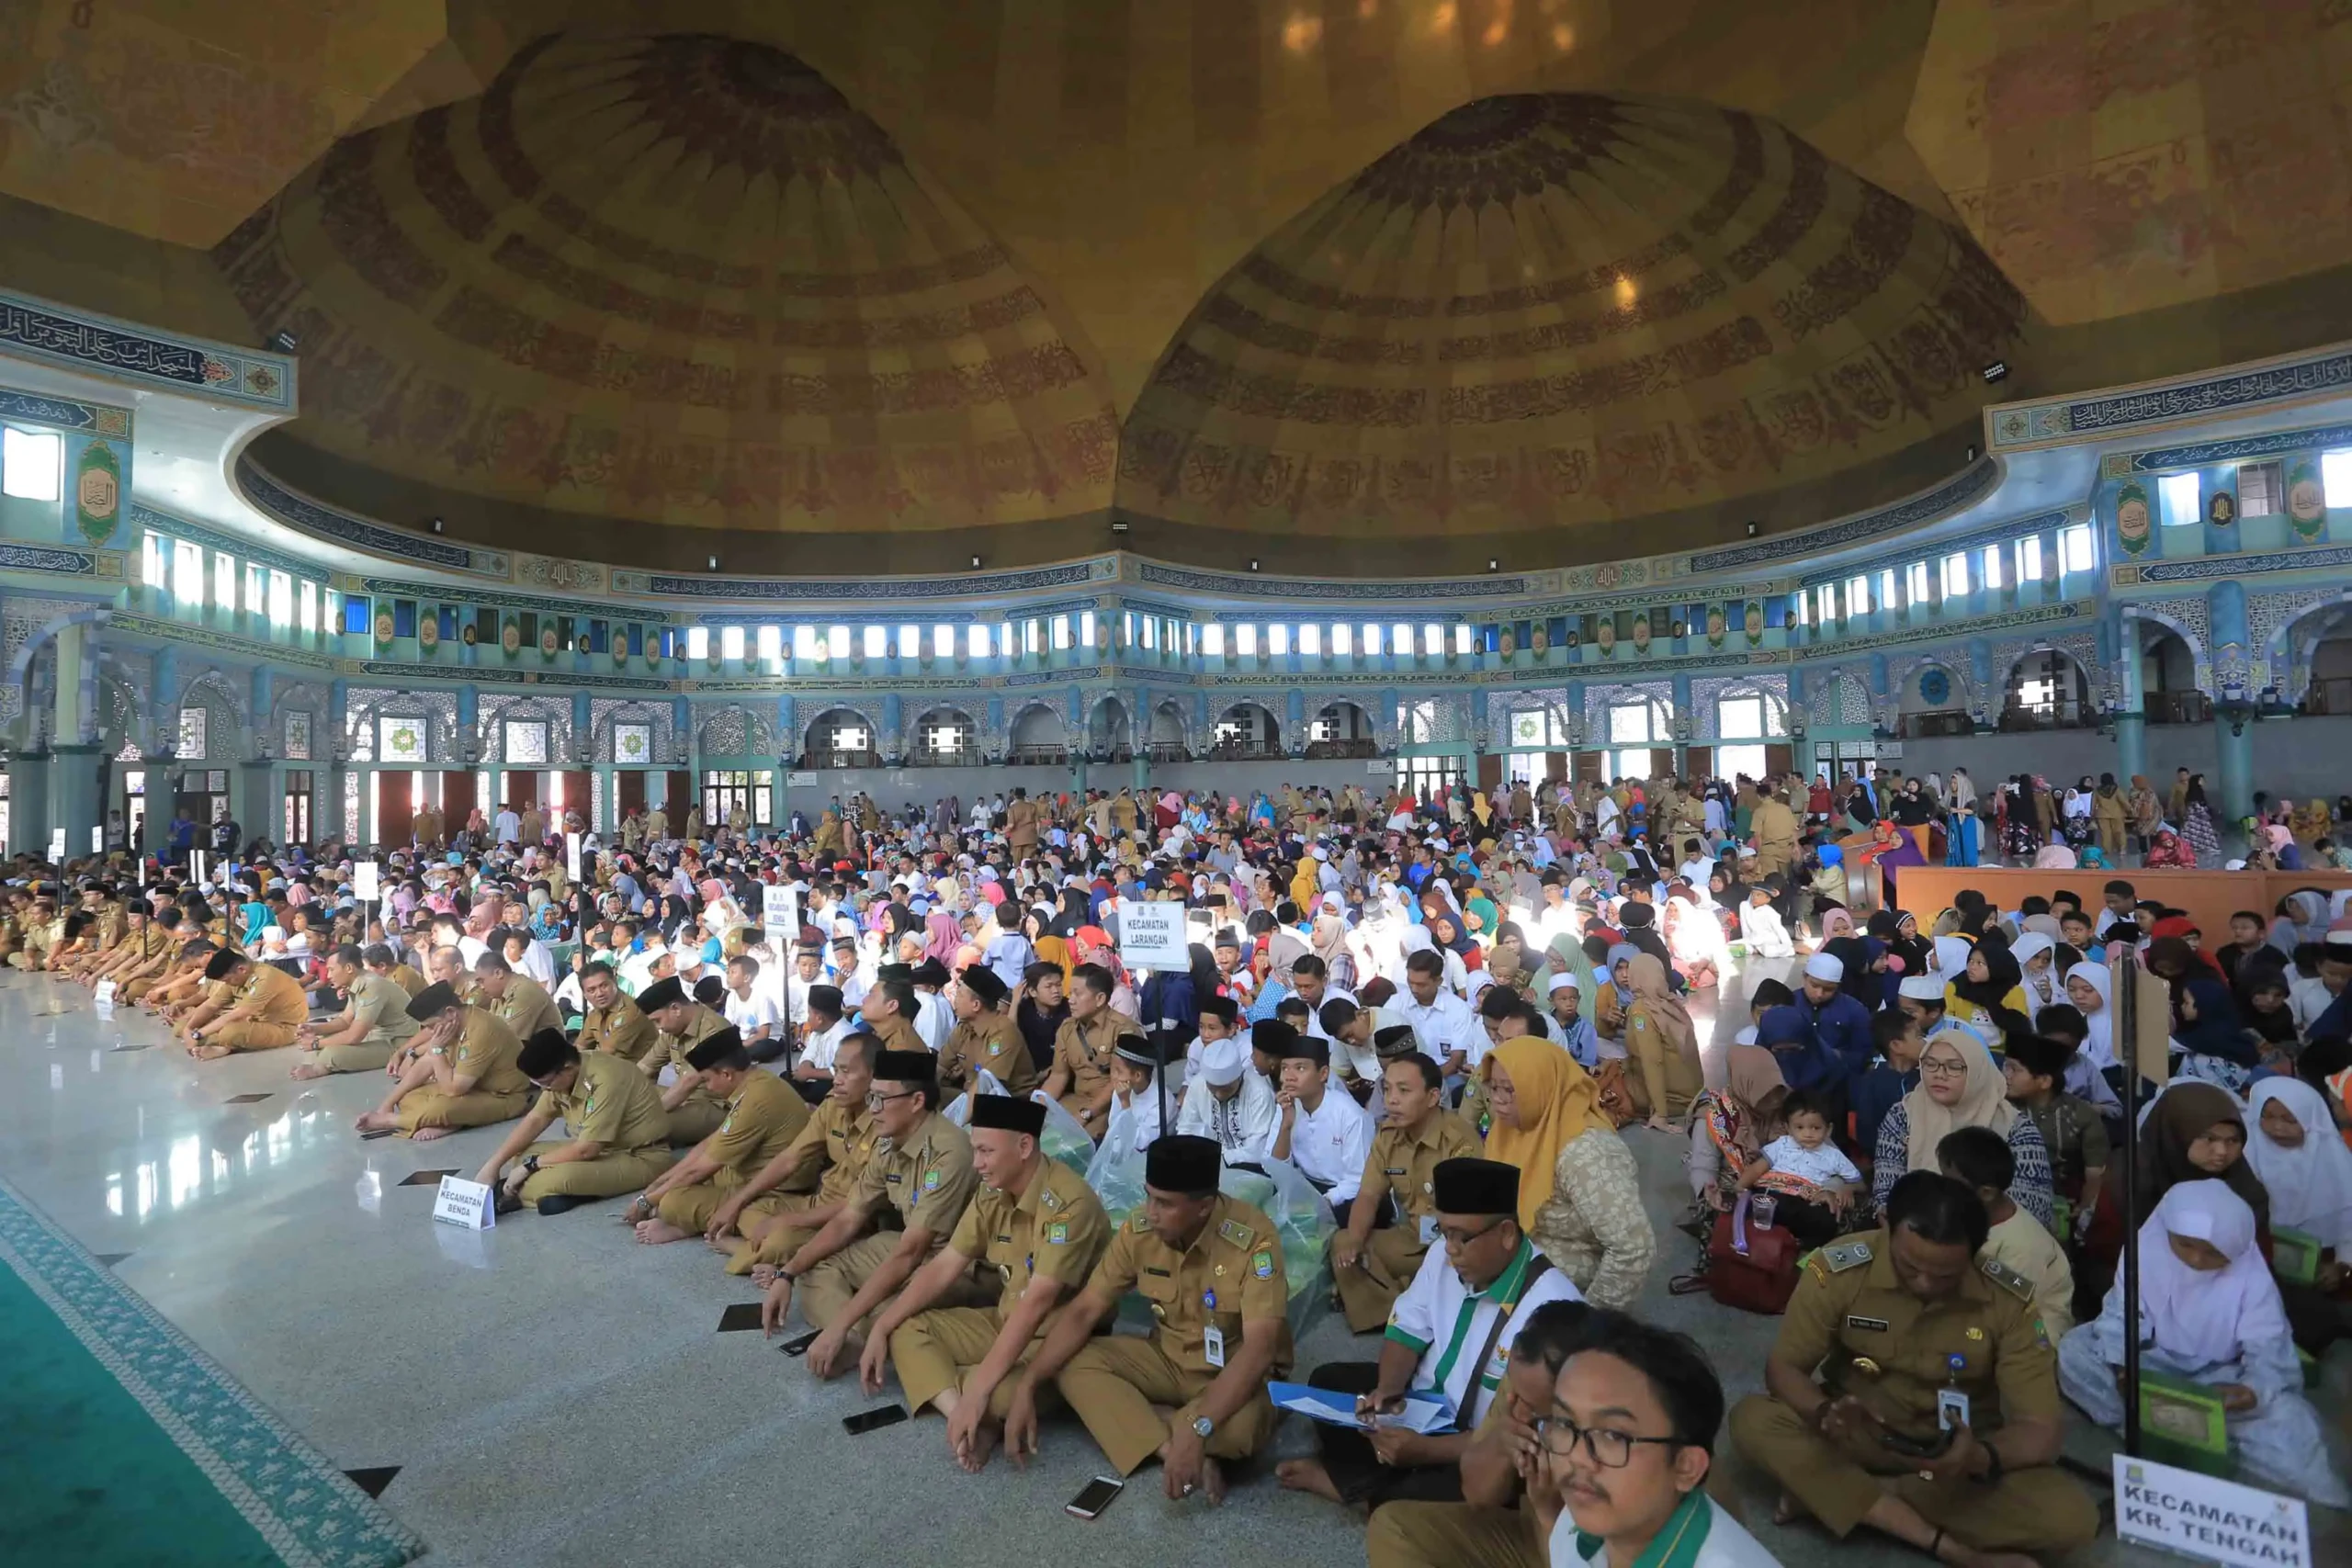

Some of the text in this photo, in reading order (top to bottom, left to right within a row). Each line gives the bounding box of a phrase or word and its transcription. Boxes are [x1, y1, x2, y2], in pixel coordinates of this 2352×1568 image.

[1128, 919, 1169, 930] KECAMATAN
[1132, 934, 1168, 944] LARANGAN
[441, 1190, 481, 1207] KECAMATAN
[447, 1204, 470, 1216] BENDA
[2124, 1484, 2299, 1545] KECAMATAN
[2125, 1506, 2171, 1532] KR.
[2178, 1519, 2301, 1568] TENGAH
